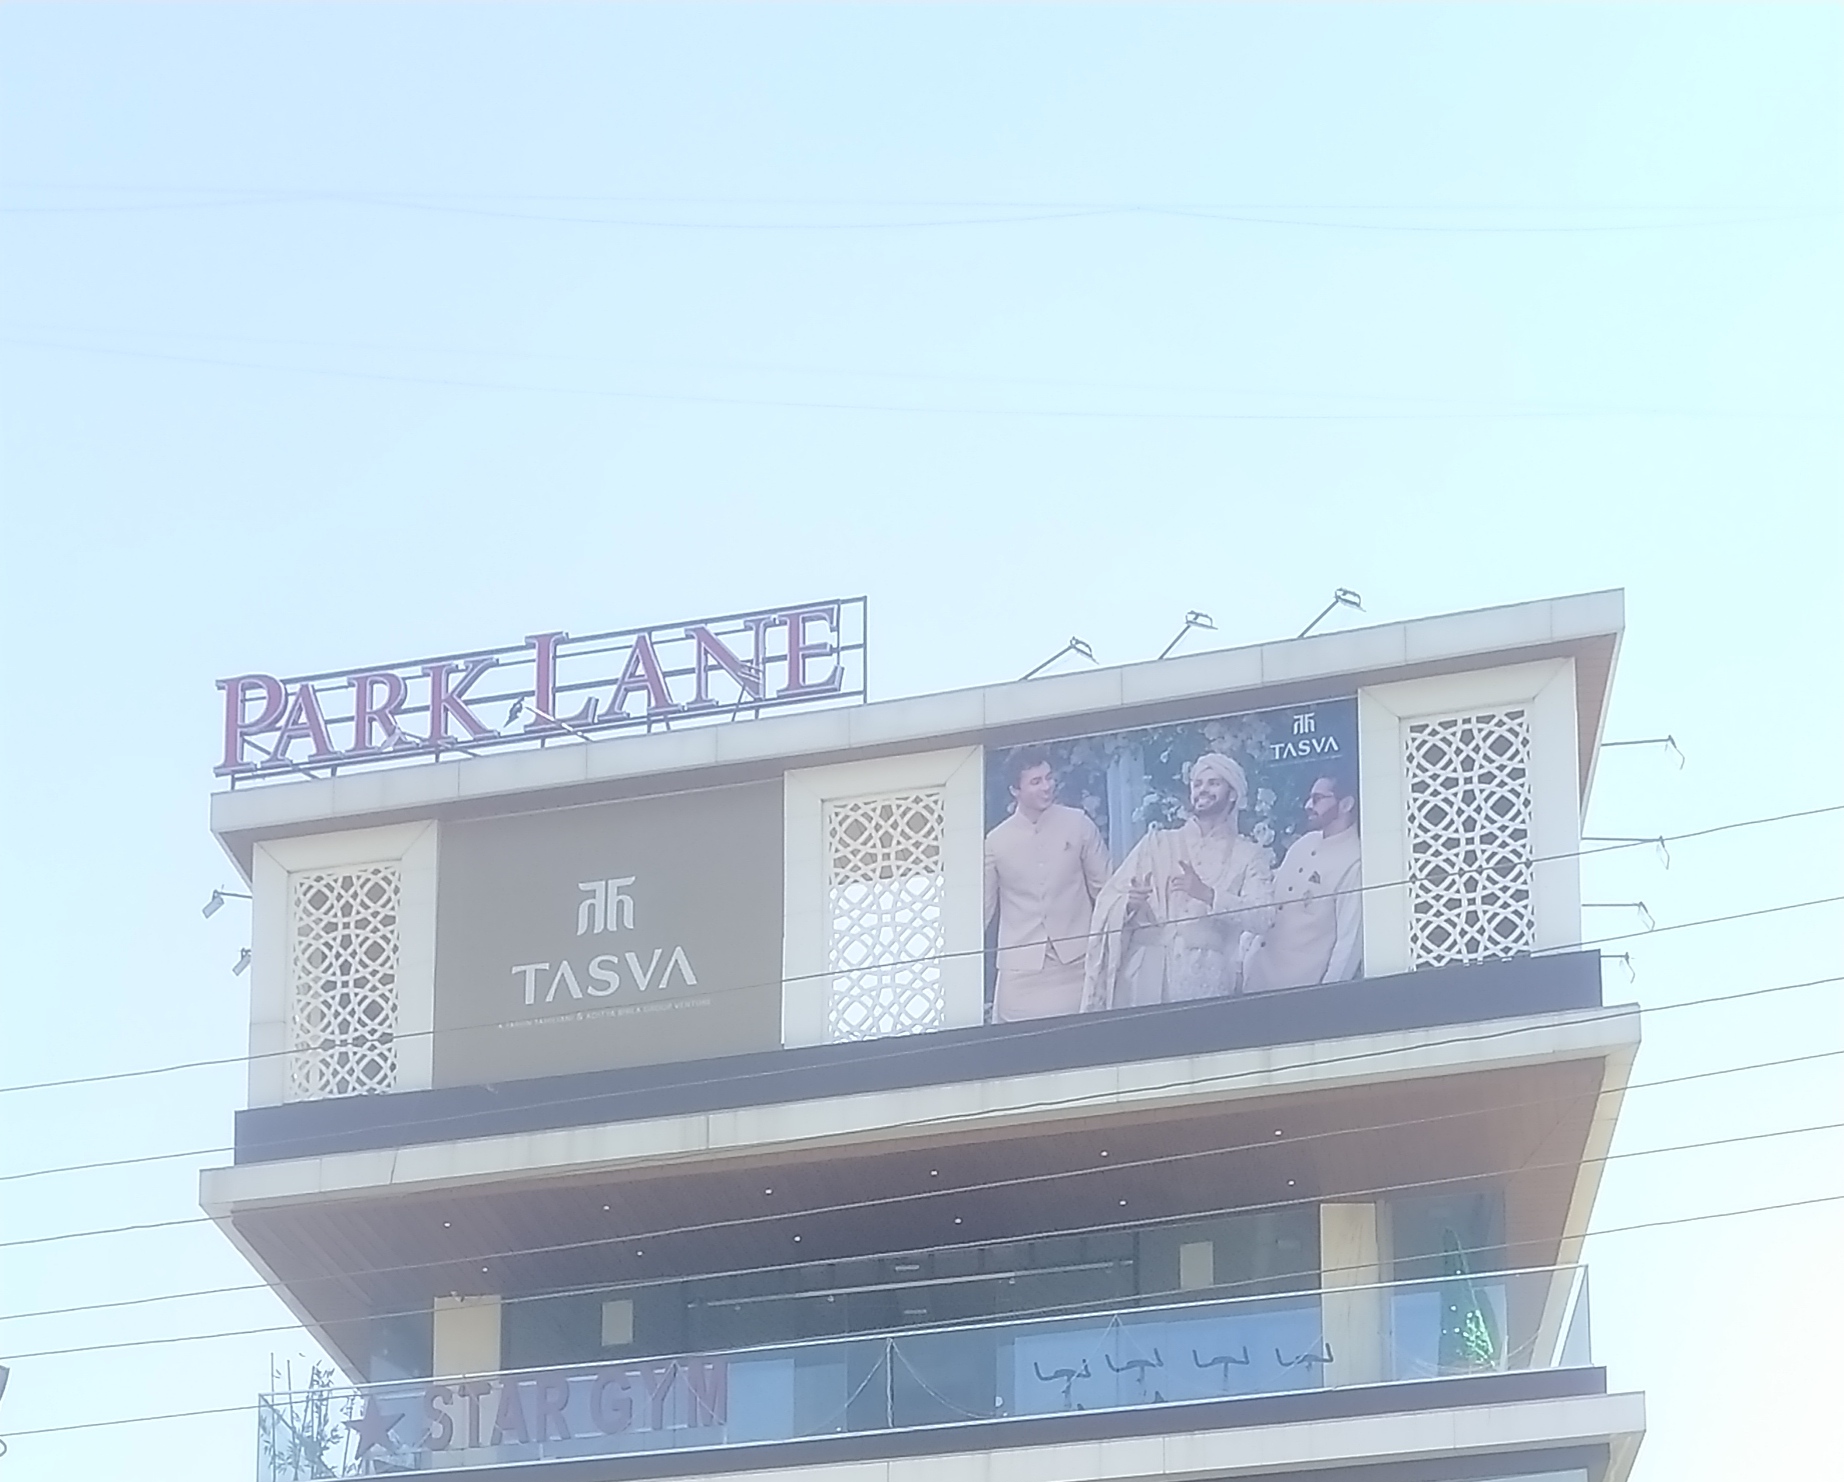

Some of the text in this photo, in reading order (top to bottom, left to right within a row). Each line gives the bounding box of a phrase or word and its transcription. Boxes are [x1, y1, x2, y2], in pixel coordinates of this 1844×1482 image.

[214, 604, 844, 776] PARK LANE
[1270, 736, 1339, 759] TASVA
[511, 945, 698, 1005] TASVA
[423, 1358, 728, 1452] STAR GYM
